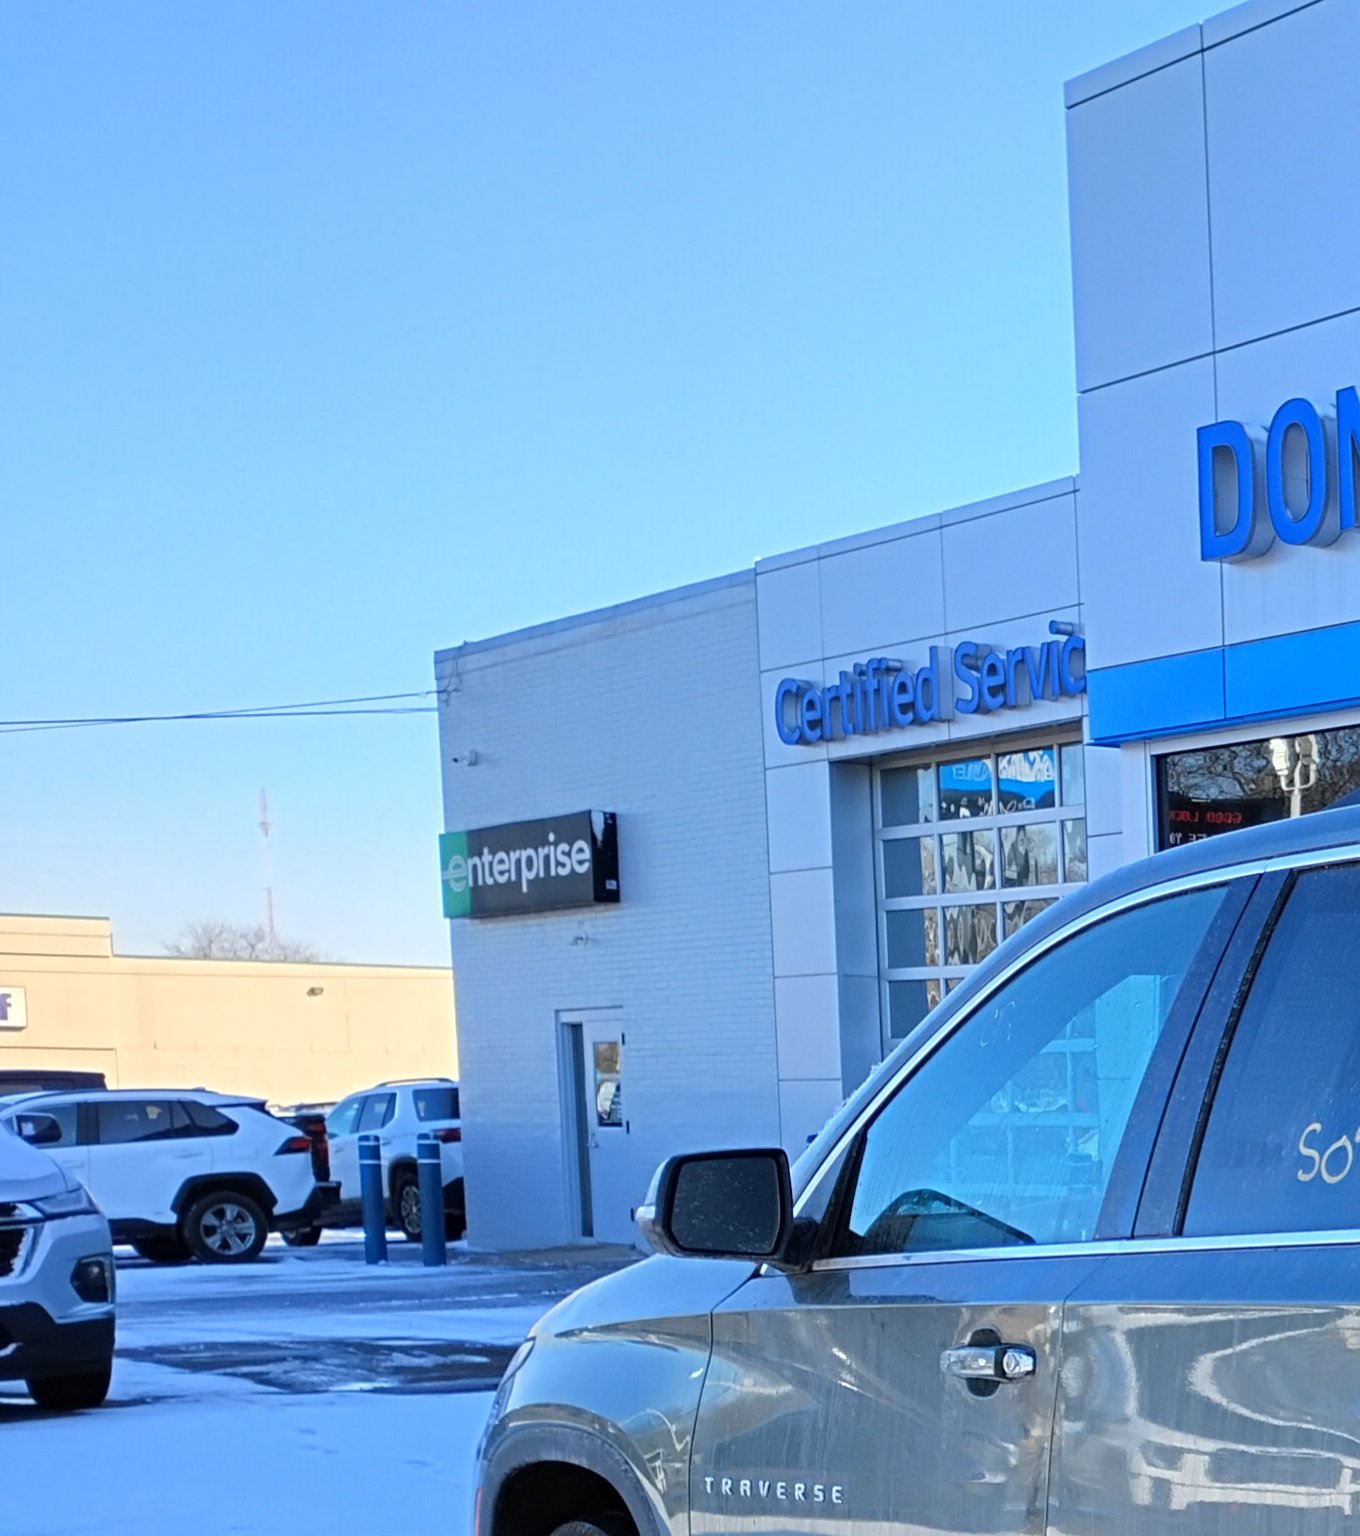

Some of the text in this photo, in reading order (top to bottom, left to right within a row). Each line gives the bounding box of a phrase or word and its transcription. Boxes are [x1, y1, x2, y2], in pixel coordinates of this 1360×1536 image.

[775, 620, 1087, 746] Certified Servic
[442, 832, 591, 894] enterprise
[704, 1476, 844, 1504] TRAVERSE
